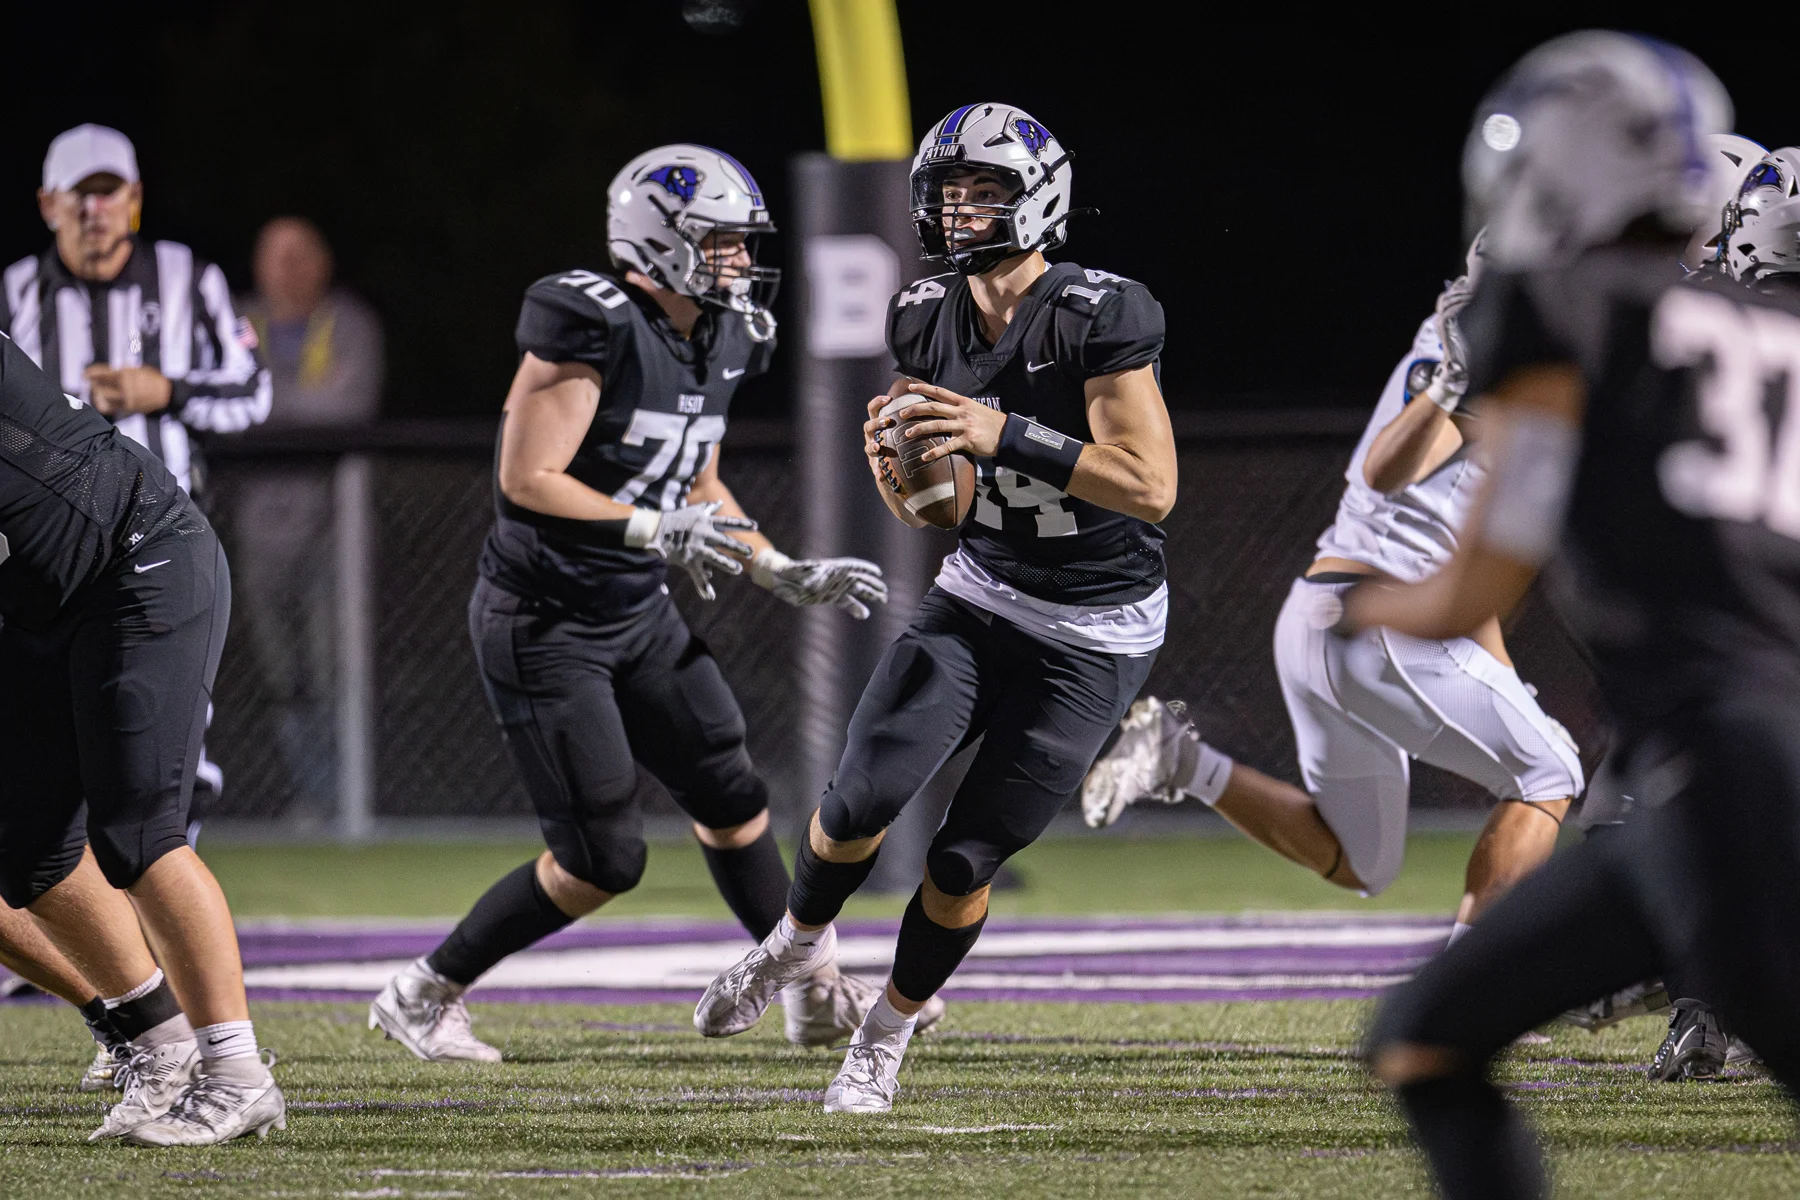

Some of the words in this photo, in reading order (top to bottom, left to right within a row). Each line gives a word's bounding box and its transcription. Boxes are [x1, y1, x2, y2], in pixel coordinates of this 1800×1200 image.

[558, 269, 630, 309] 70
[804, 235, 900, 357] B
[1062, 269, 1131, 305] 14
[611, 408, 726, 512] 70
[129, 532, 144, 545] XL
